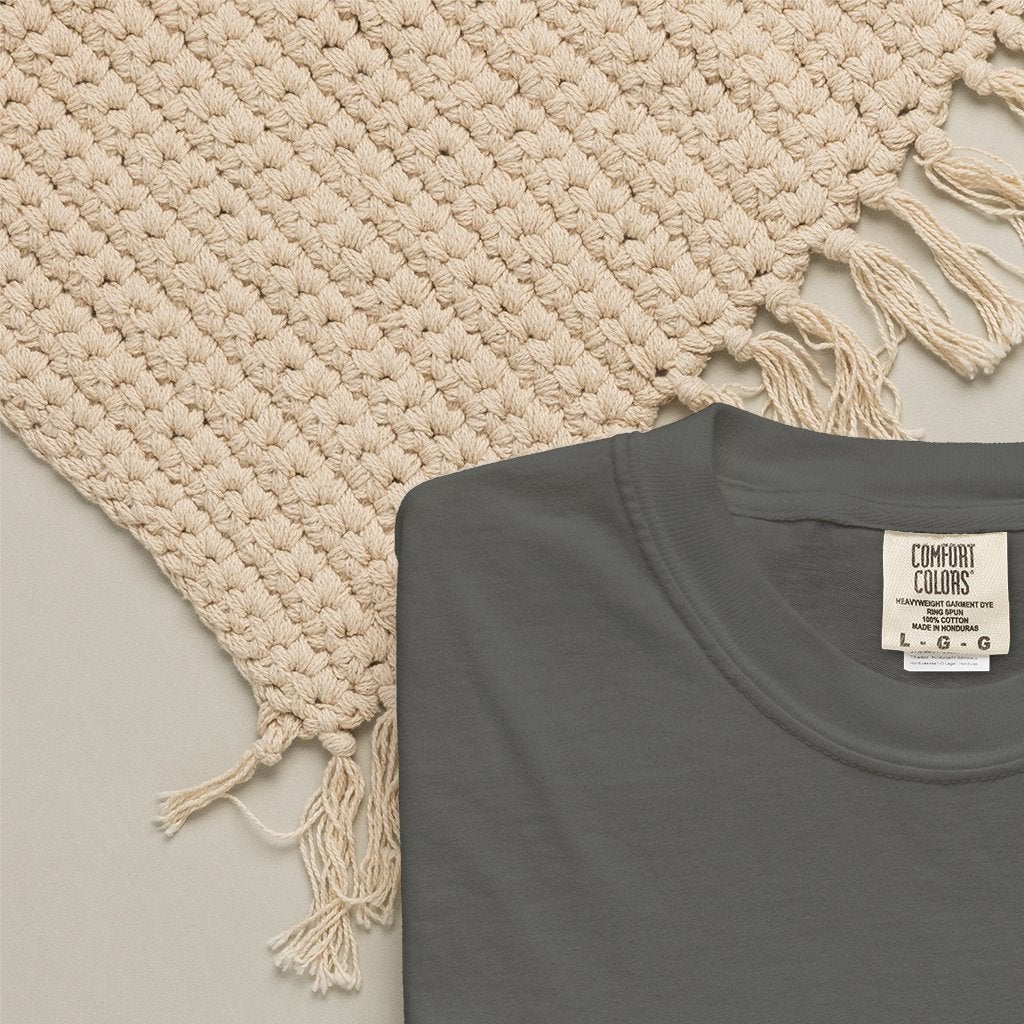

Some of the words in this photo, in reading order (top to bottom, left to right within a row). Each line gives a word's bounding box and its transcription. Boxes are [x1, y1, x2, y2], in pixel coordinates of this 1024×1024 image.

[911, 542, 976, 569] COMFORT
[895, 597, 945, 608] HEAVYWEIGHT
[945, 600, 979, 609] GARMENT
[979, 601, 994, 609] DYE
[926, 608, 944, 616] RING
[944, 608, 964, 617] SPUN
[922, 616, 940, 624] 100%
[940, 616, 969, 625] COTTON
[911, 623, 932, 632] MADE
[932, 624, 940, 632] IN
[940, 624, 979, 633] HONDURAS
[900, 632, 911, 648] L
[936, 635, 951, 651] G
[977, 635, 991, 651] G
